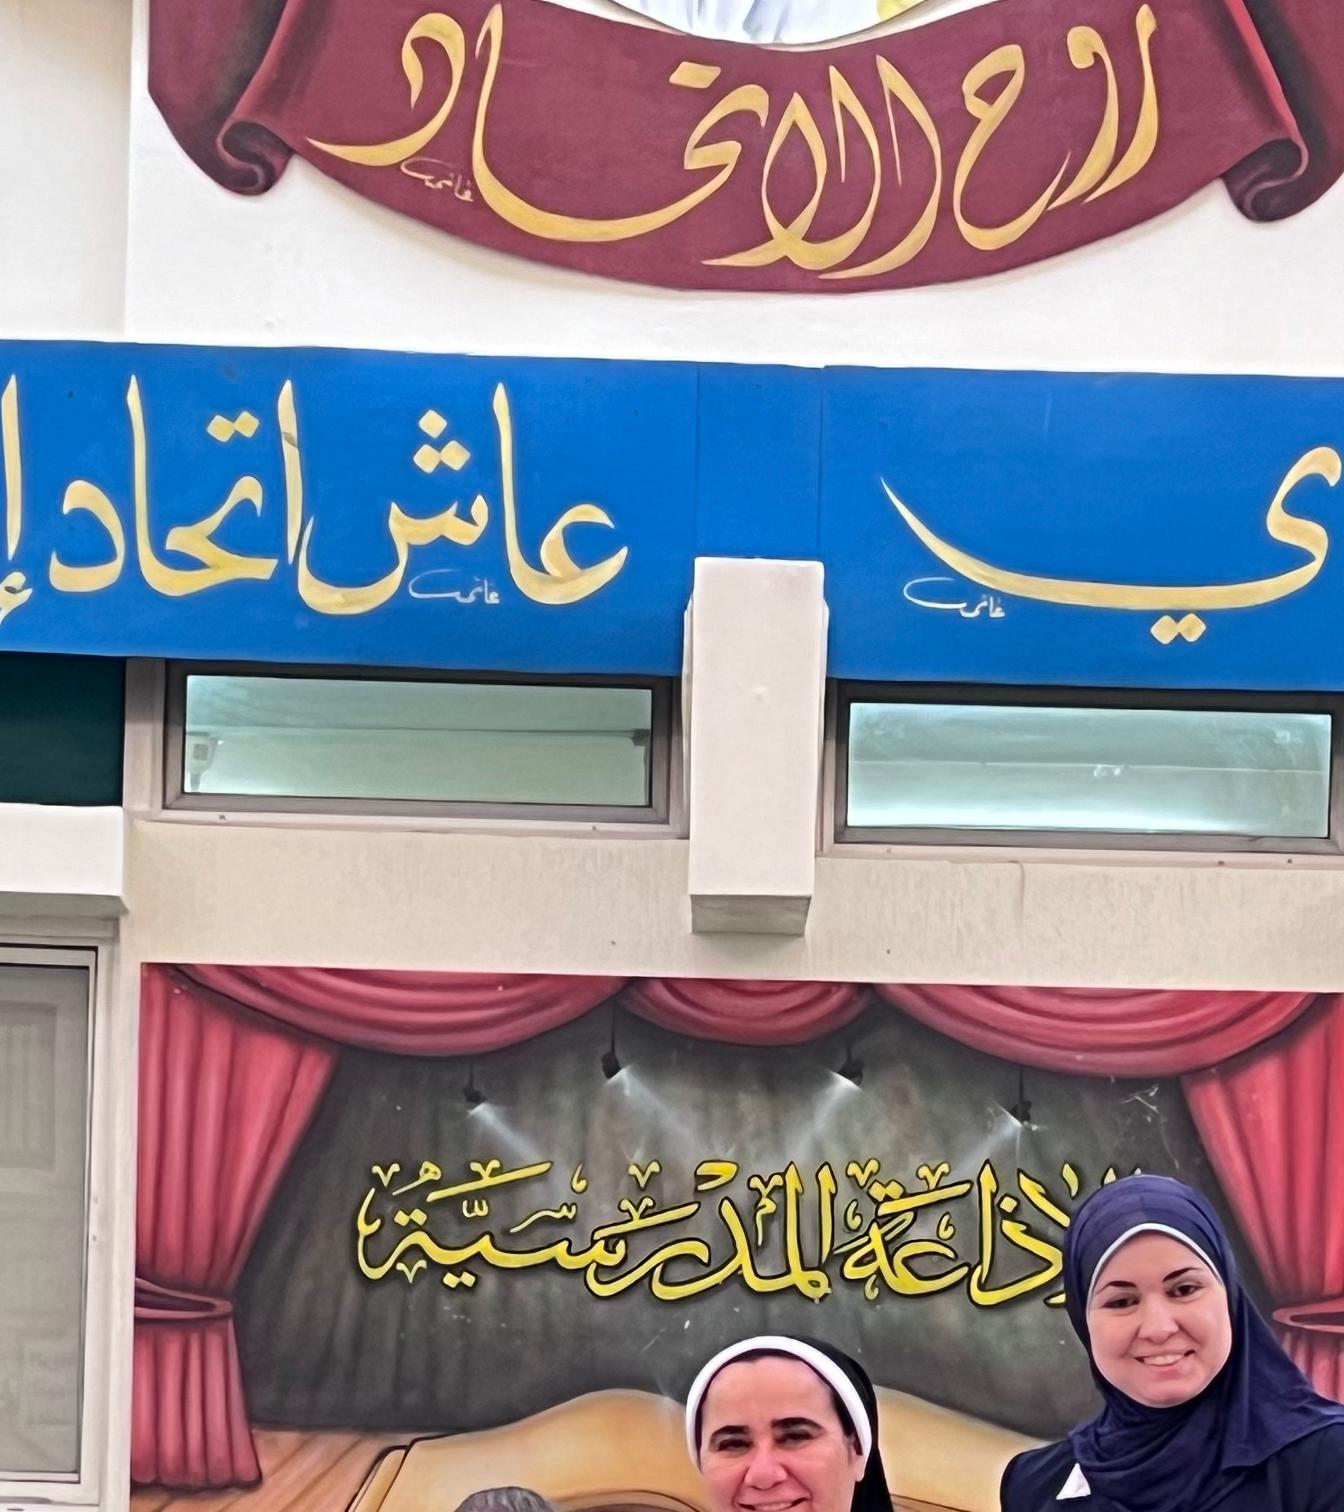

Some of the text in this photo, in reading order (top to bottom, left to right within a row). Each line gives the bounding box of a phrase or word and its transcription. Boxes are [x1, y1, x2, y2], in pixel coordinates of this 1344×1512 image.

[305, 4, 1158, 279] روح الاتحاد
[48, 372, 304, 597] اتحاد
[296, 381, 628, 616] عاش
